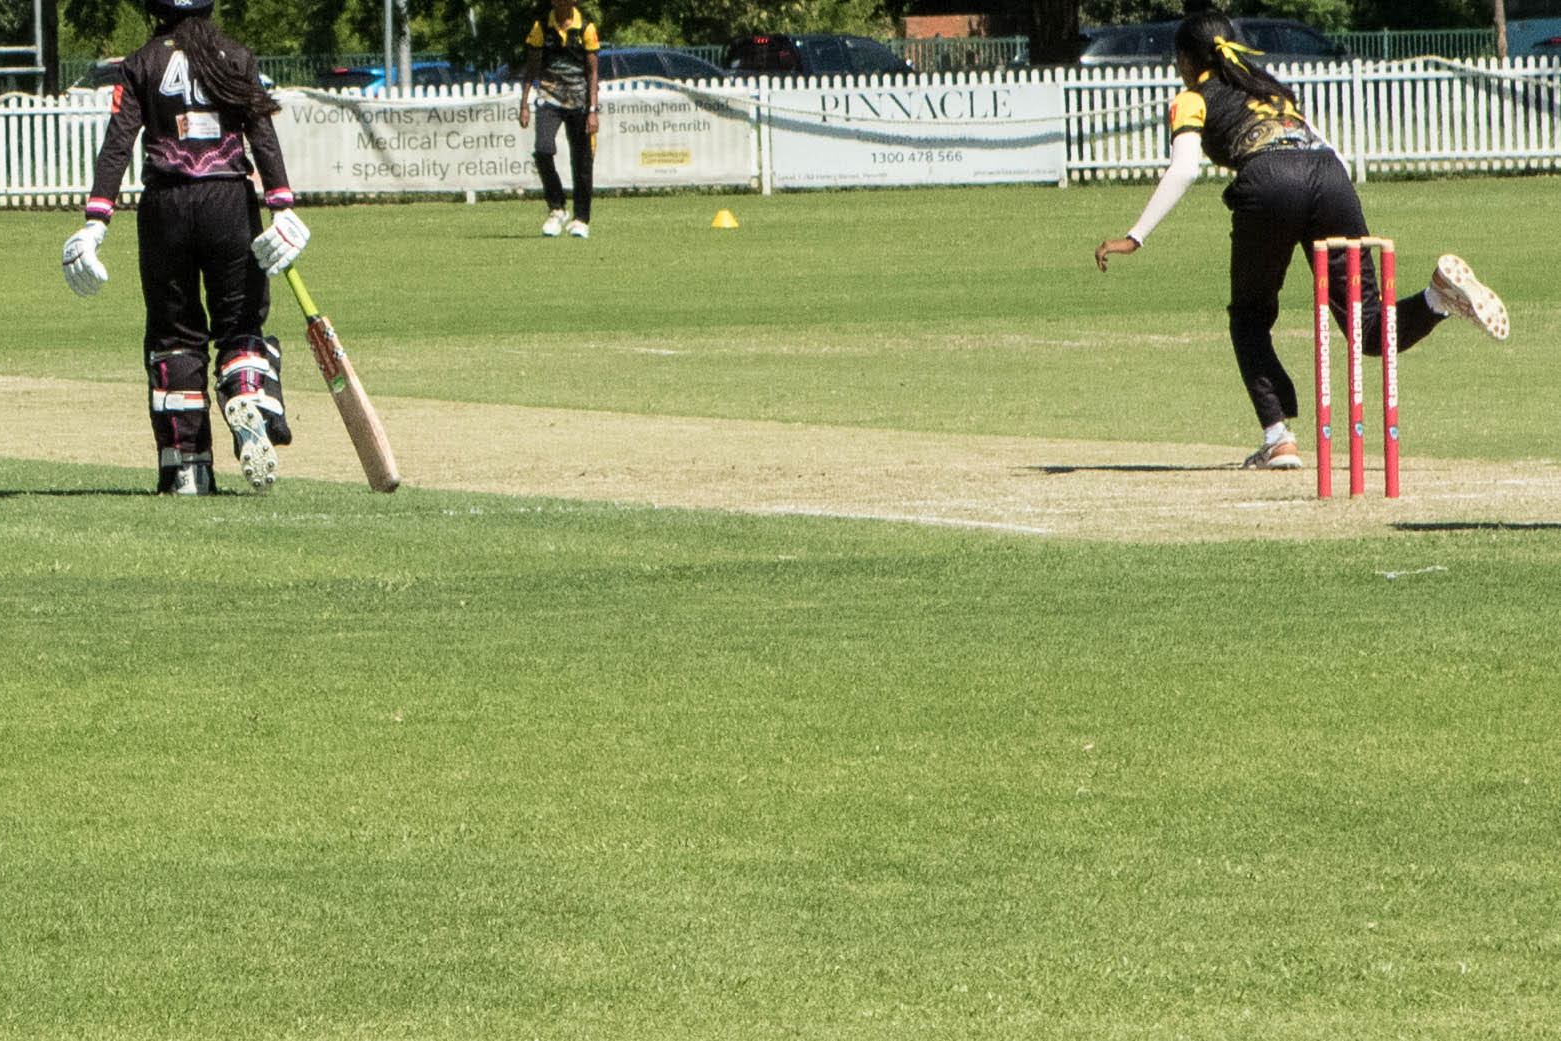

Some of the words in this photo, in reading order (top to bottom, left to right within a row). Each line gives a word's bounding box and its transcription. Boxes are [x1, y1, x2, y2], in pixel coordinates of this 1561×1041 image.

[426, 105, 520, 123] Australia
[607, 100, 691, 116] Birmingham
[820, 88, 1012, 122] PINNACLE
[619, 121, 659, 134] South
[662, 119, 711, 133] Penrith
[357, 131, 437, 150] Medical
[445, 130, 516, 150] Centre
[871, 151, 904, 164] 1300
[907, 151, 934, 163] 478
[938, 150, 963, 162] 566
[352, 157, 450, 181] speciality
[458, 156, 538, 176] retailers
